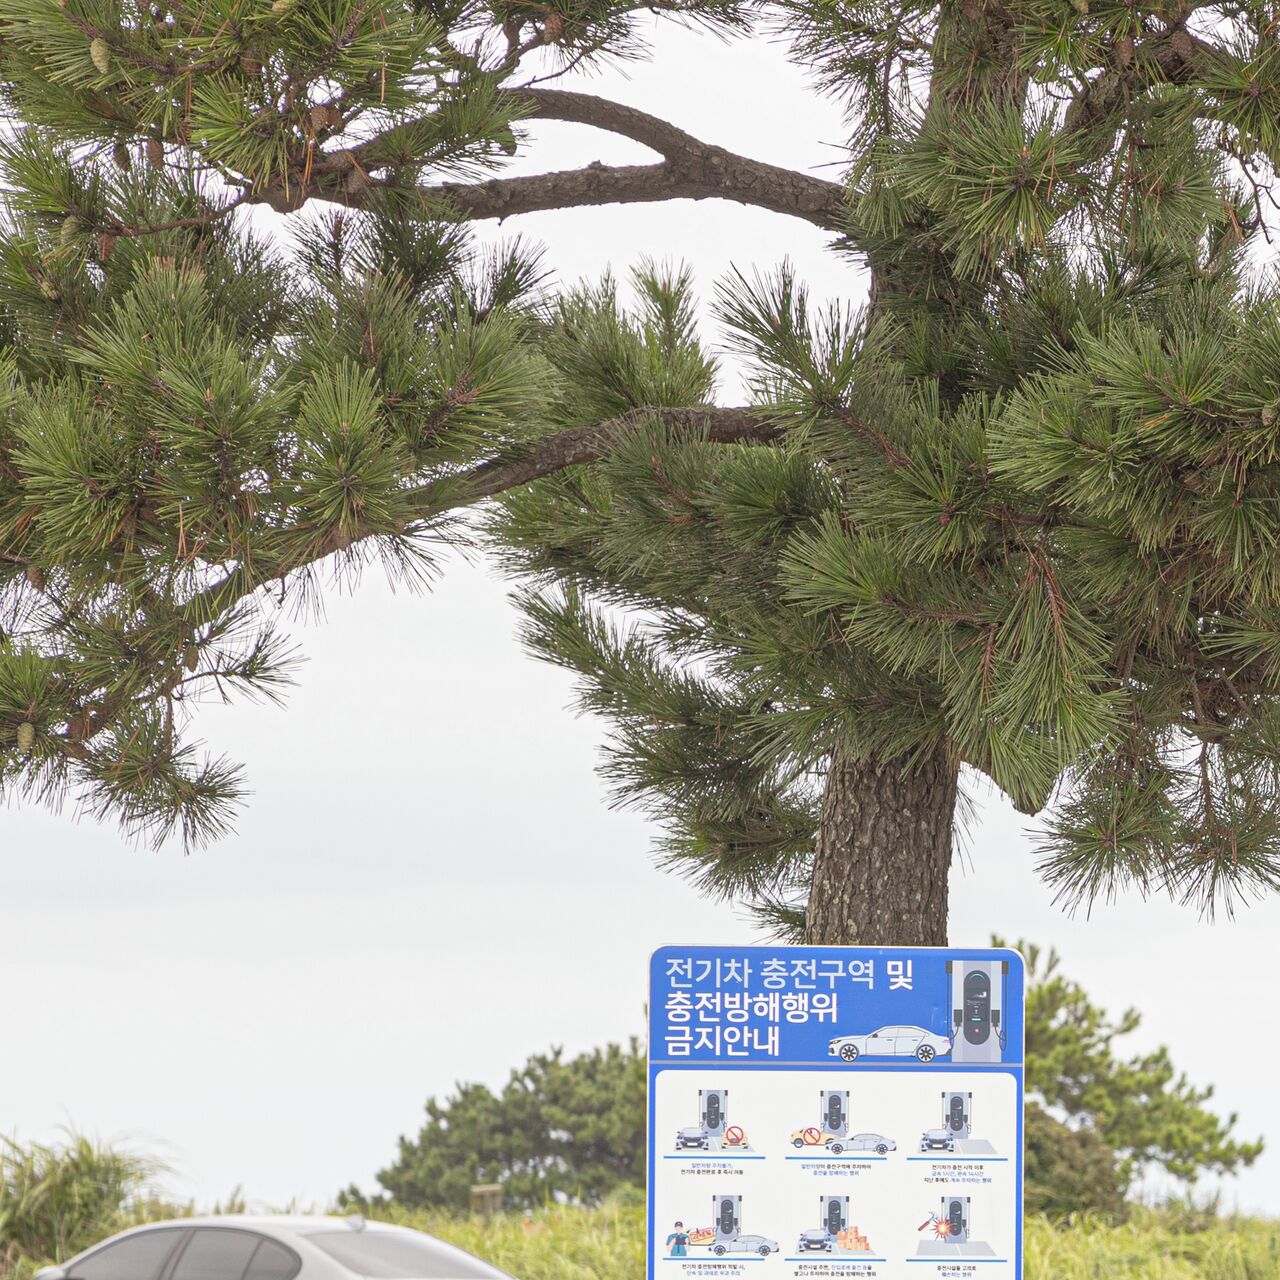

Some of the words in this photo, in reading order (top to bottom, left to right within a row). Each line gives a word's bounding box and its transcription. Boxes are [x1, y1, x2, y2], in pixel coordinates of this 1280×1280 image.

[664, 958, 752, 990] 전기차
[760, 958, 876, 990] 충전구역
[886, 959, 914, 992] 및
[664, 991, 838, 1024] 충전방해행위
[664, 1025, 780, 1057] 금지안내
